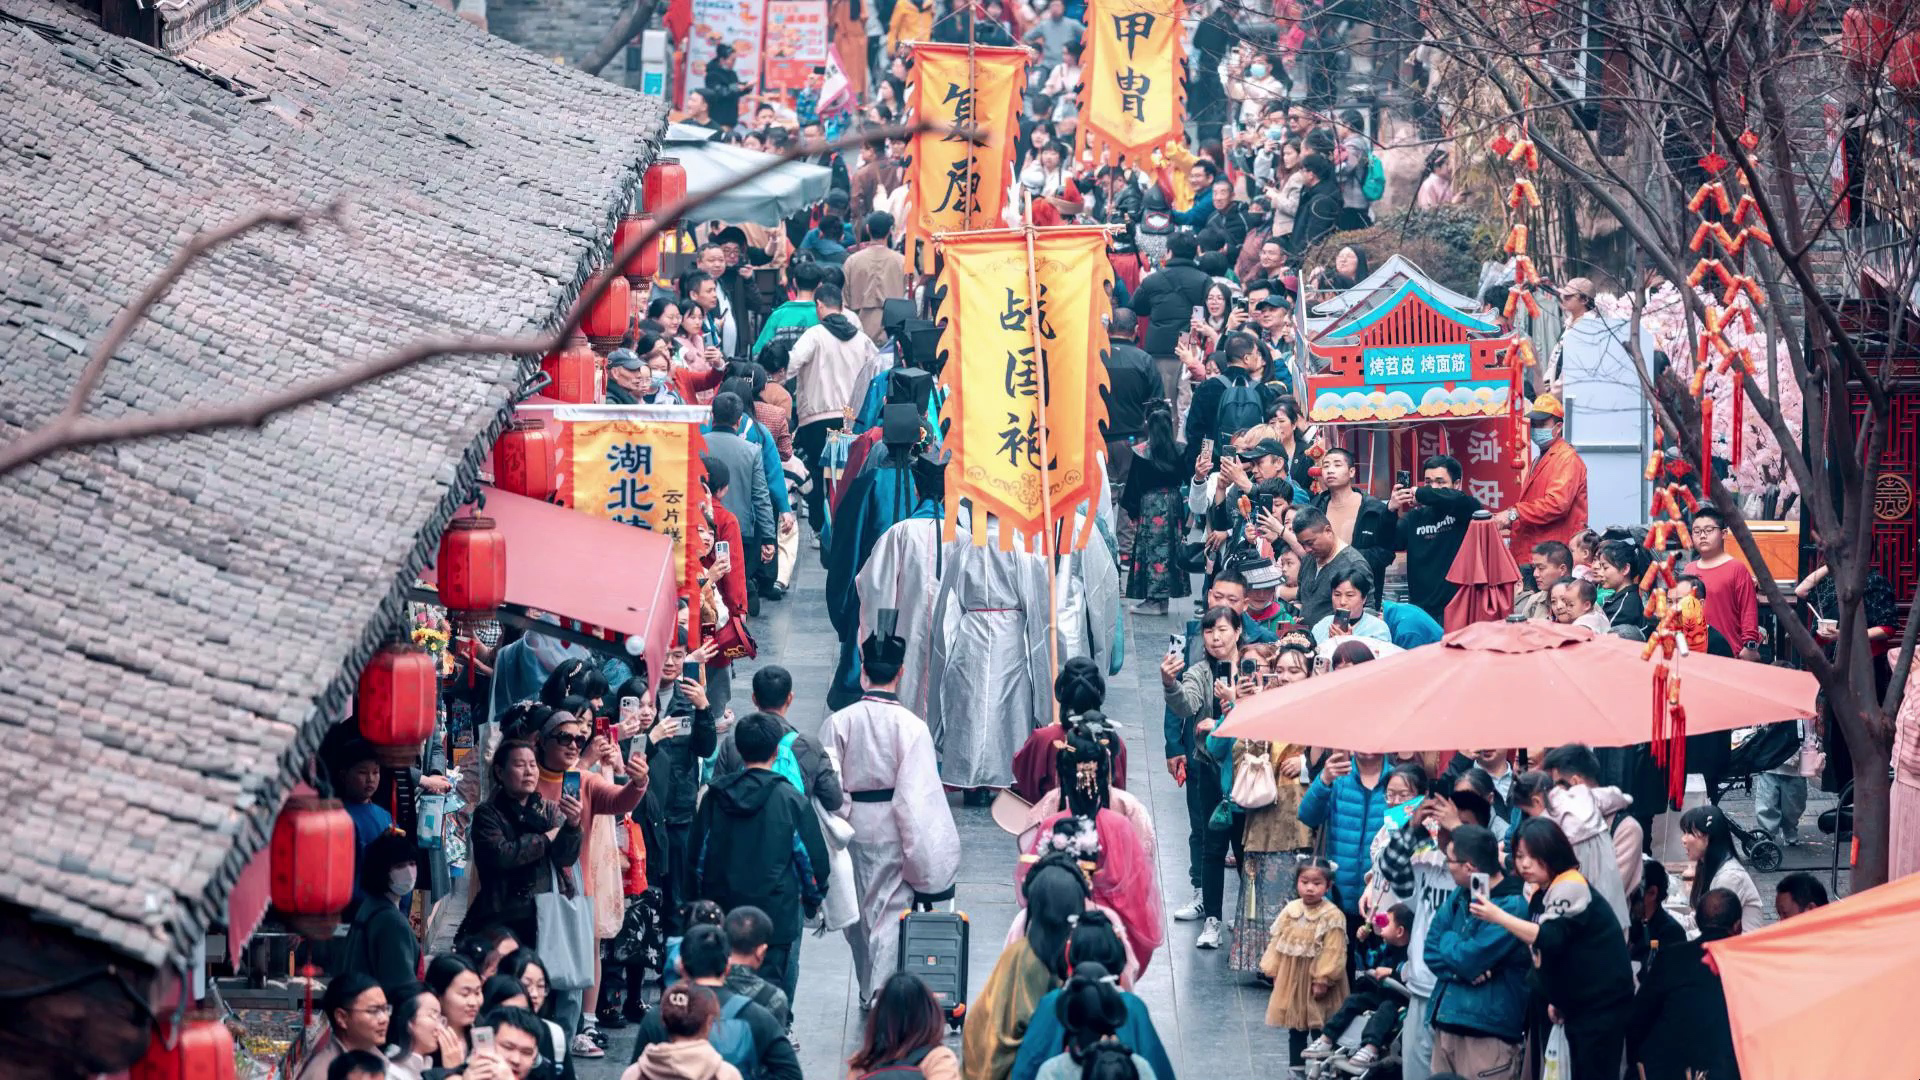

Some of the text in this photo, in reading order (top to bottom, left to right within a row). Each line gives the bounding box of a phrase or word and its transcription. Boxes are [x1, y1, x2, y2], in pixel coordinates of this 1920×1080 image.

[1112, 12, 1156, 123] 甲胄
[996, 283, 1057, 471] 战国袍
[1369, 351, 1466, 377] 烤苕皮 烤面筋
